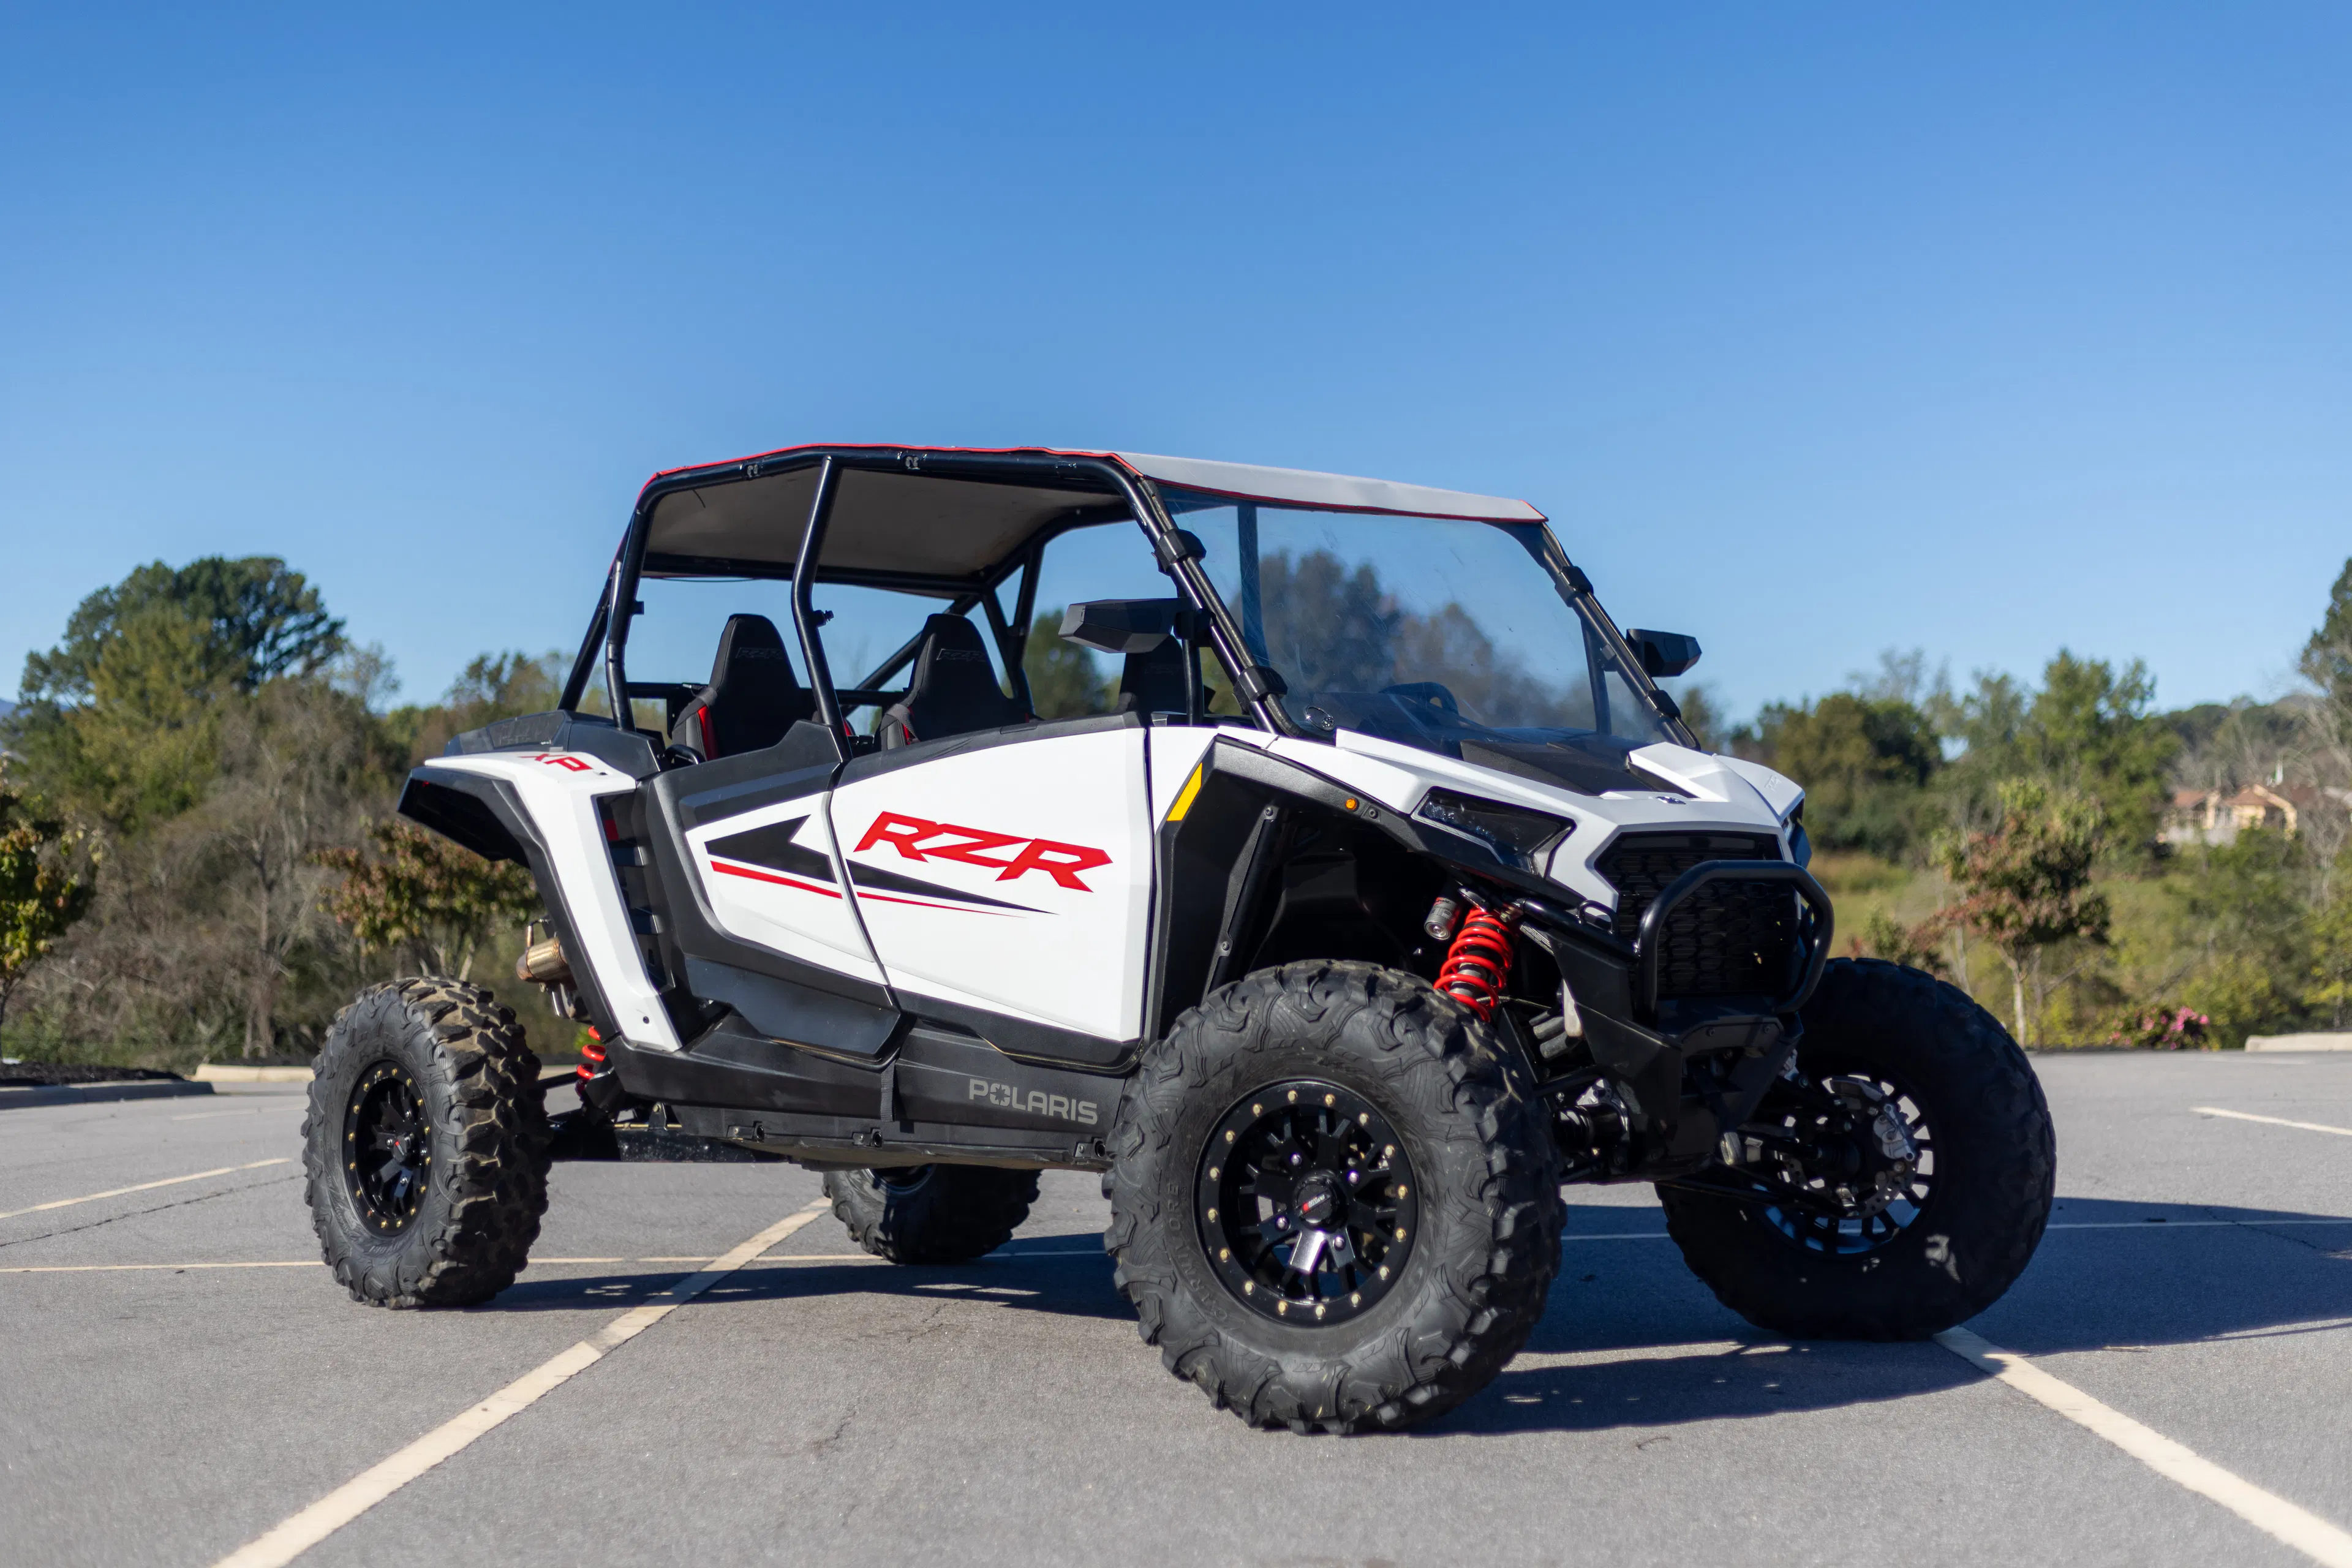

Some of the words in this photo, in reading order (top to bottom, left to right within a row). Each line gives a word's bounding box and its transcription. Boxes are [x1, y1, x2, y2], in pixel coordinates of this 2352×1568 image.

[518, 753, 593, 771] XP
[853, 811, 1113, 892] RZR
[969, 1079, 1098, 1125] POLARIS
